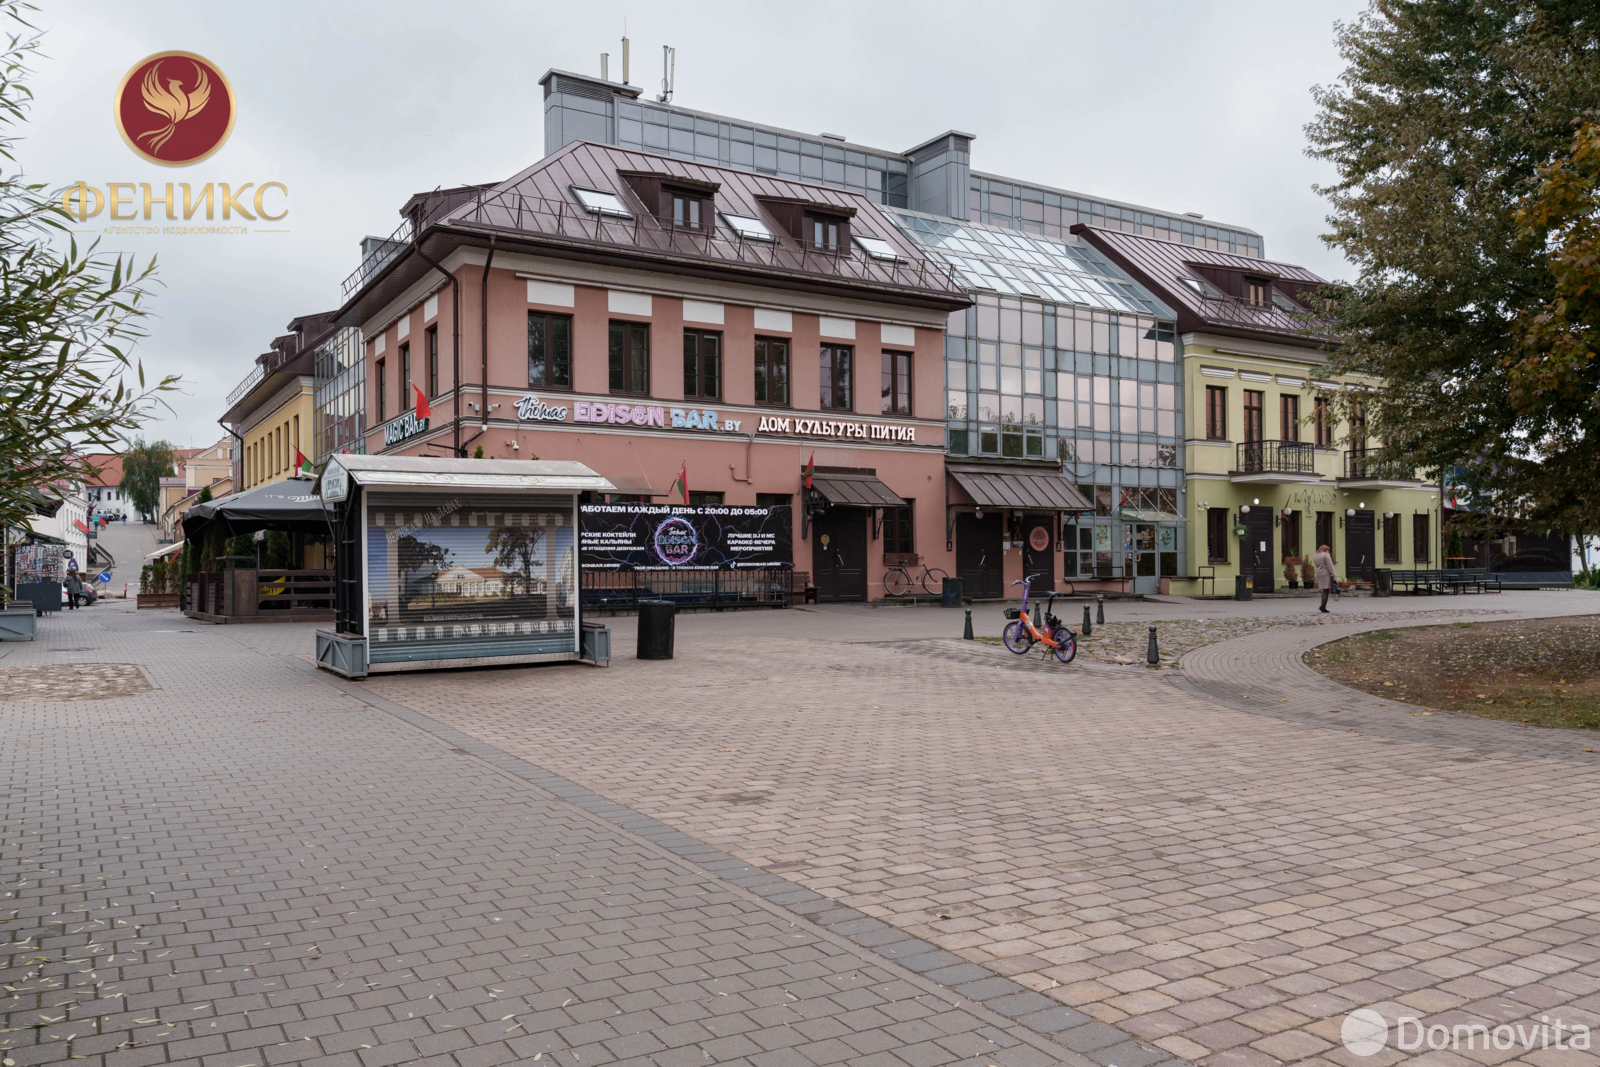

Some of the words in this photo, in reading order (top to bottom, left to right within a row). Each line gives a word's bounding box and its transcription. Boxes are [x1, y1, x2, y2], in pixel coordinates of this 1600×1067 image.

[513, 396, 568, 421] Thomas
[573, 402, 665, 428] EDISON
[384, 419, 404, 445] MAGIC
[758, 416, 790, 432] ДОМ
[794, 419, 867, 438] КУЛЬТУРЫ
[870, 425, 915, 441] ПИТИЯ
[424, 512, 437, 524] НА
[437, 498, 462, 518] ЛАВАХ
[580, 505, 626, 513] АБОТАЕМ
[627, 506, 670, 515] КАЖДЫЙ
[671, 507, 696, 515] ДЕНЬ
[730, 508, 743, 516] ДО
[665, 545, 689, 554] BAR
